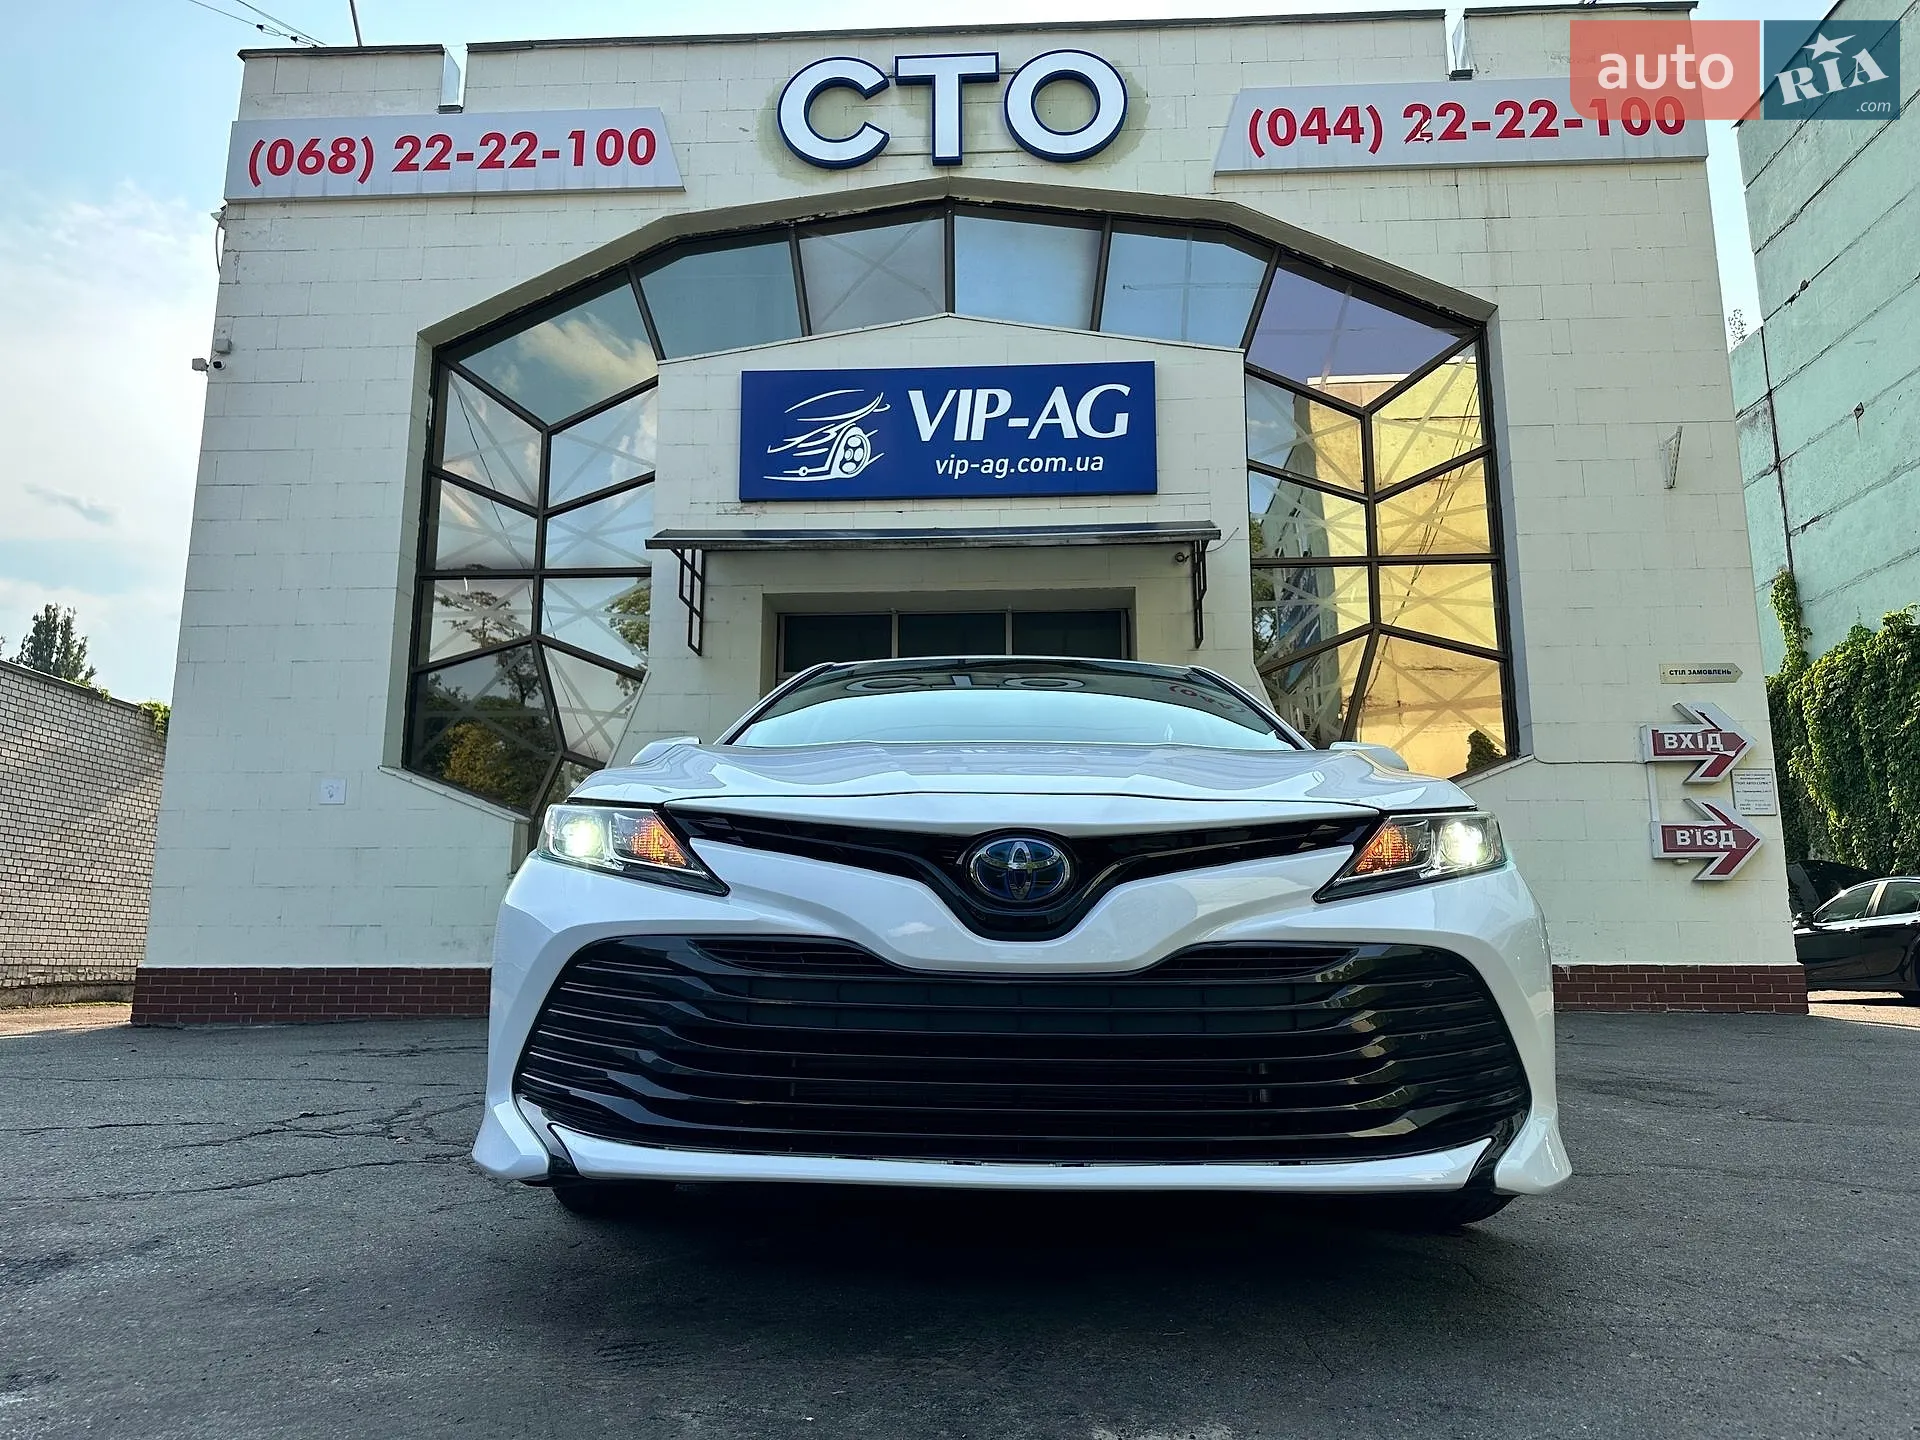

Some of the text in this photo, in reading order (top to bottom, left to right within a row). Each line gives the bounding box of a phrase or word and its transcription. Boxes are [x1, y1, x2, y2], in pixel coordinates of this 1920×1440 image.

[777, 49, 1128, 170] СТО
[1248, 95, 1685, 158] (044) 22-22-100
[248, 127, 657, 187] (068) 22-22-100
[908, 384, 1131, 442] VIP-AG
[935, 453, 1104, 479] vip-ag.com.ua
[1663, 733, 1724, 752] ВХІД
[1676, 828, 1736, 849] В'ЇЗД
